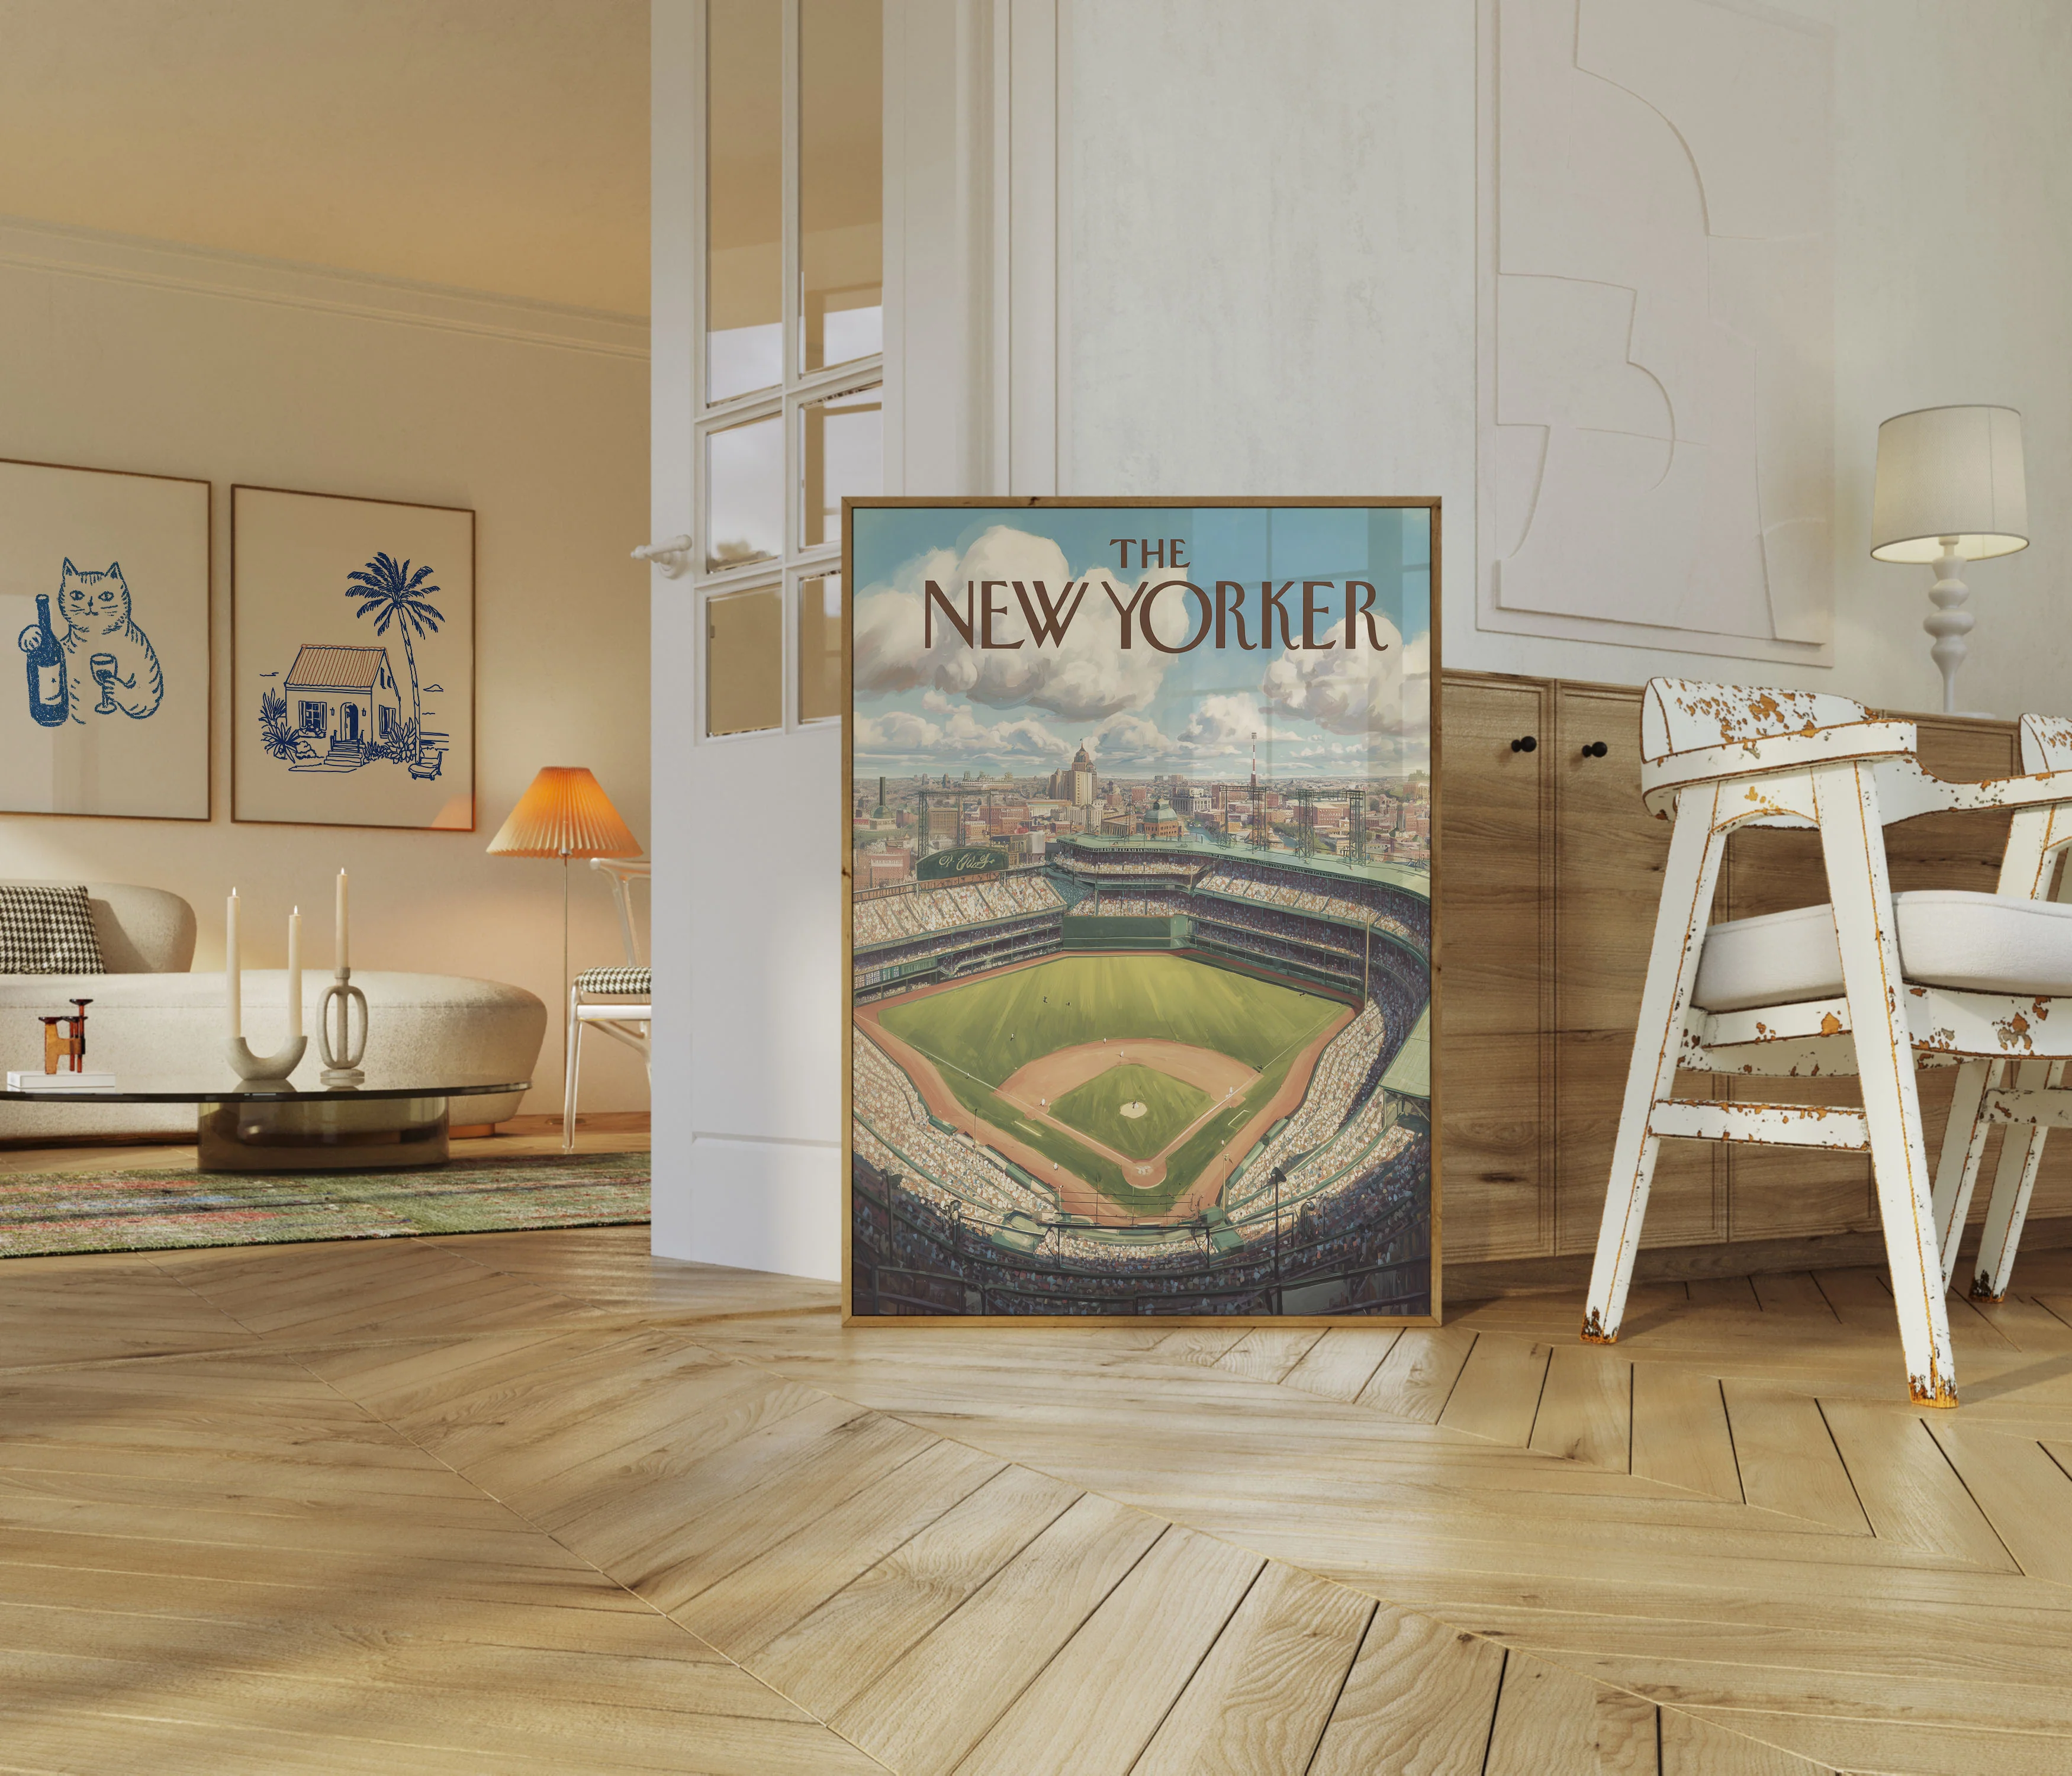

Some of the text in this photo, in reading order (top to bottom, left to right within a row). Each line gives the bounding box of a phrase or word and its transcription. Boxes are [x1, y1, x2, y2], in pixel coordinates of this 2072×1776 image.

[1109, 539, 1191, 569] THE
[925, 580, 1389, 654] NEW YORKER
